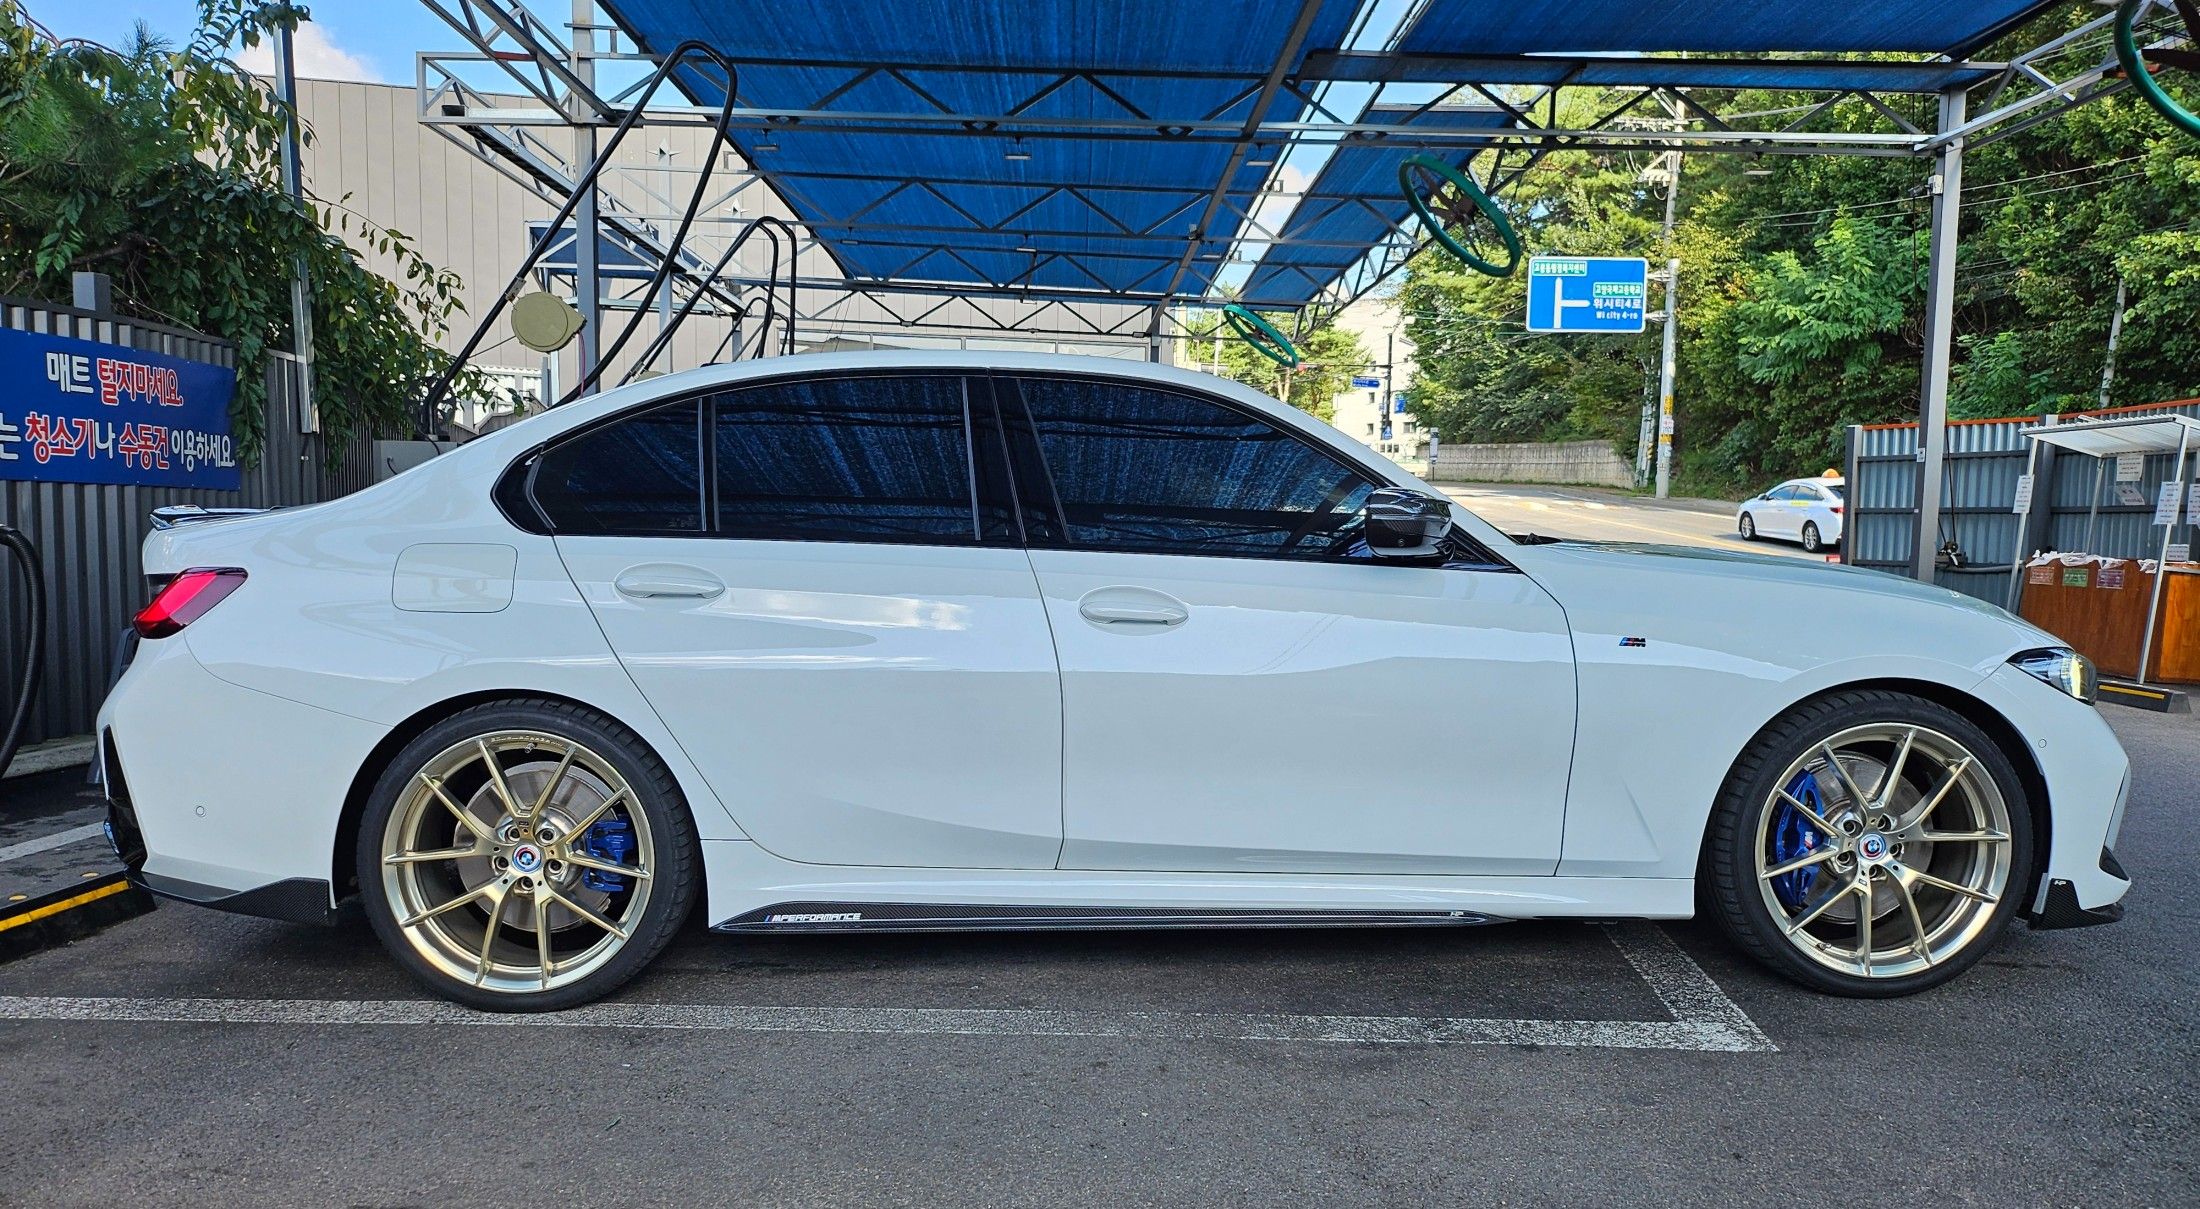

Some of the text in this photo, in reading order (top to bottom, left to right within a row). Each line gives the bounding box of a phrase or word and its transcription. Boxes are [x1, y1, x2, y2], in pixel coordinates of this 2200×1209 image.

[1593, 298, 1642, 309] 위시티4로
[47, 352, 94, 394] 매트
[25, 411, 116, 464] 청소기나
[118, 423, 170, 471] 수동건
